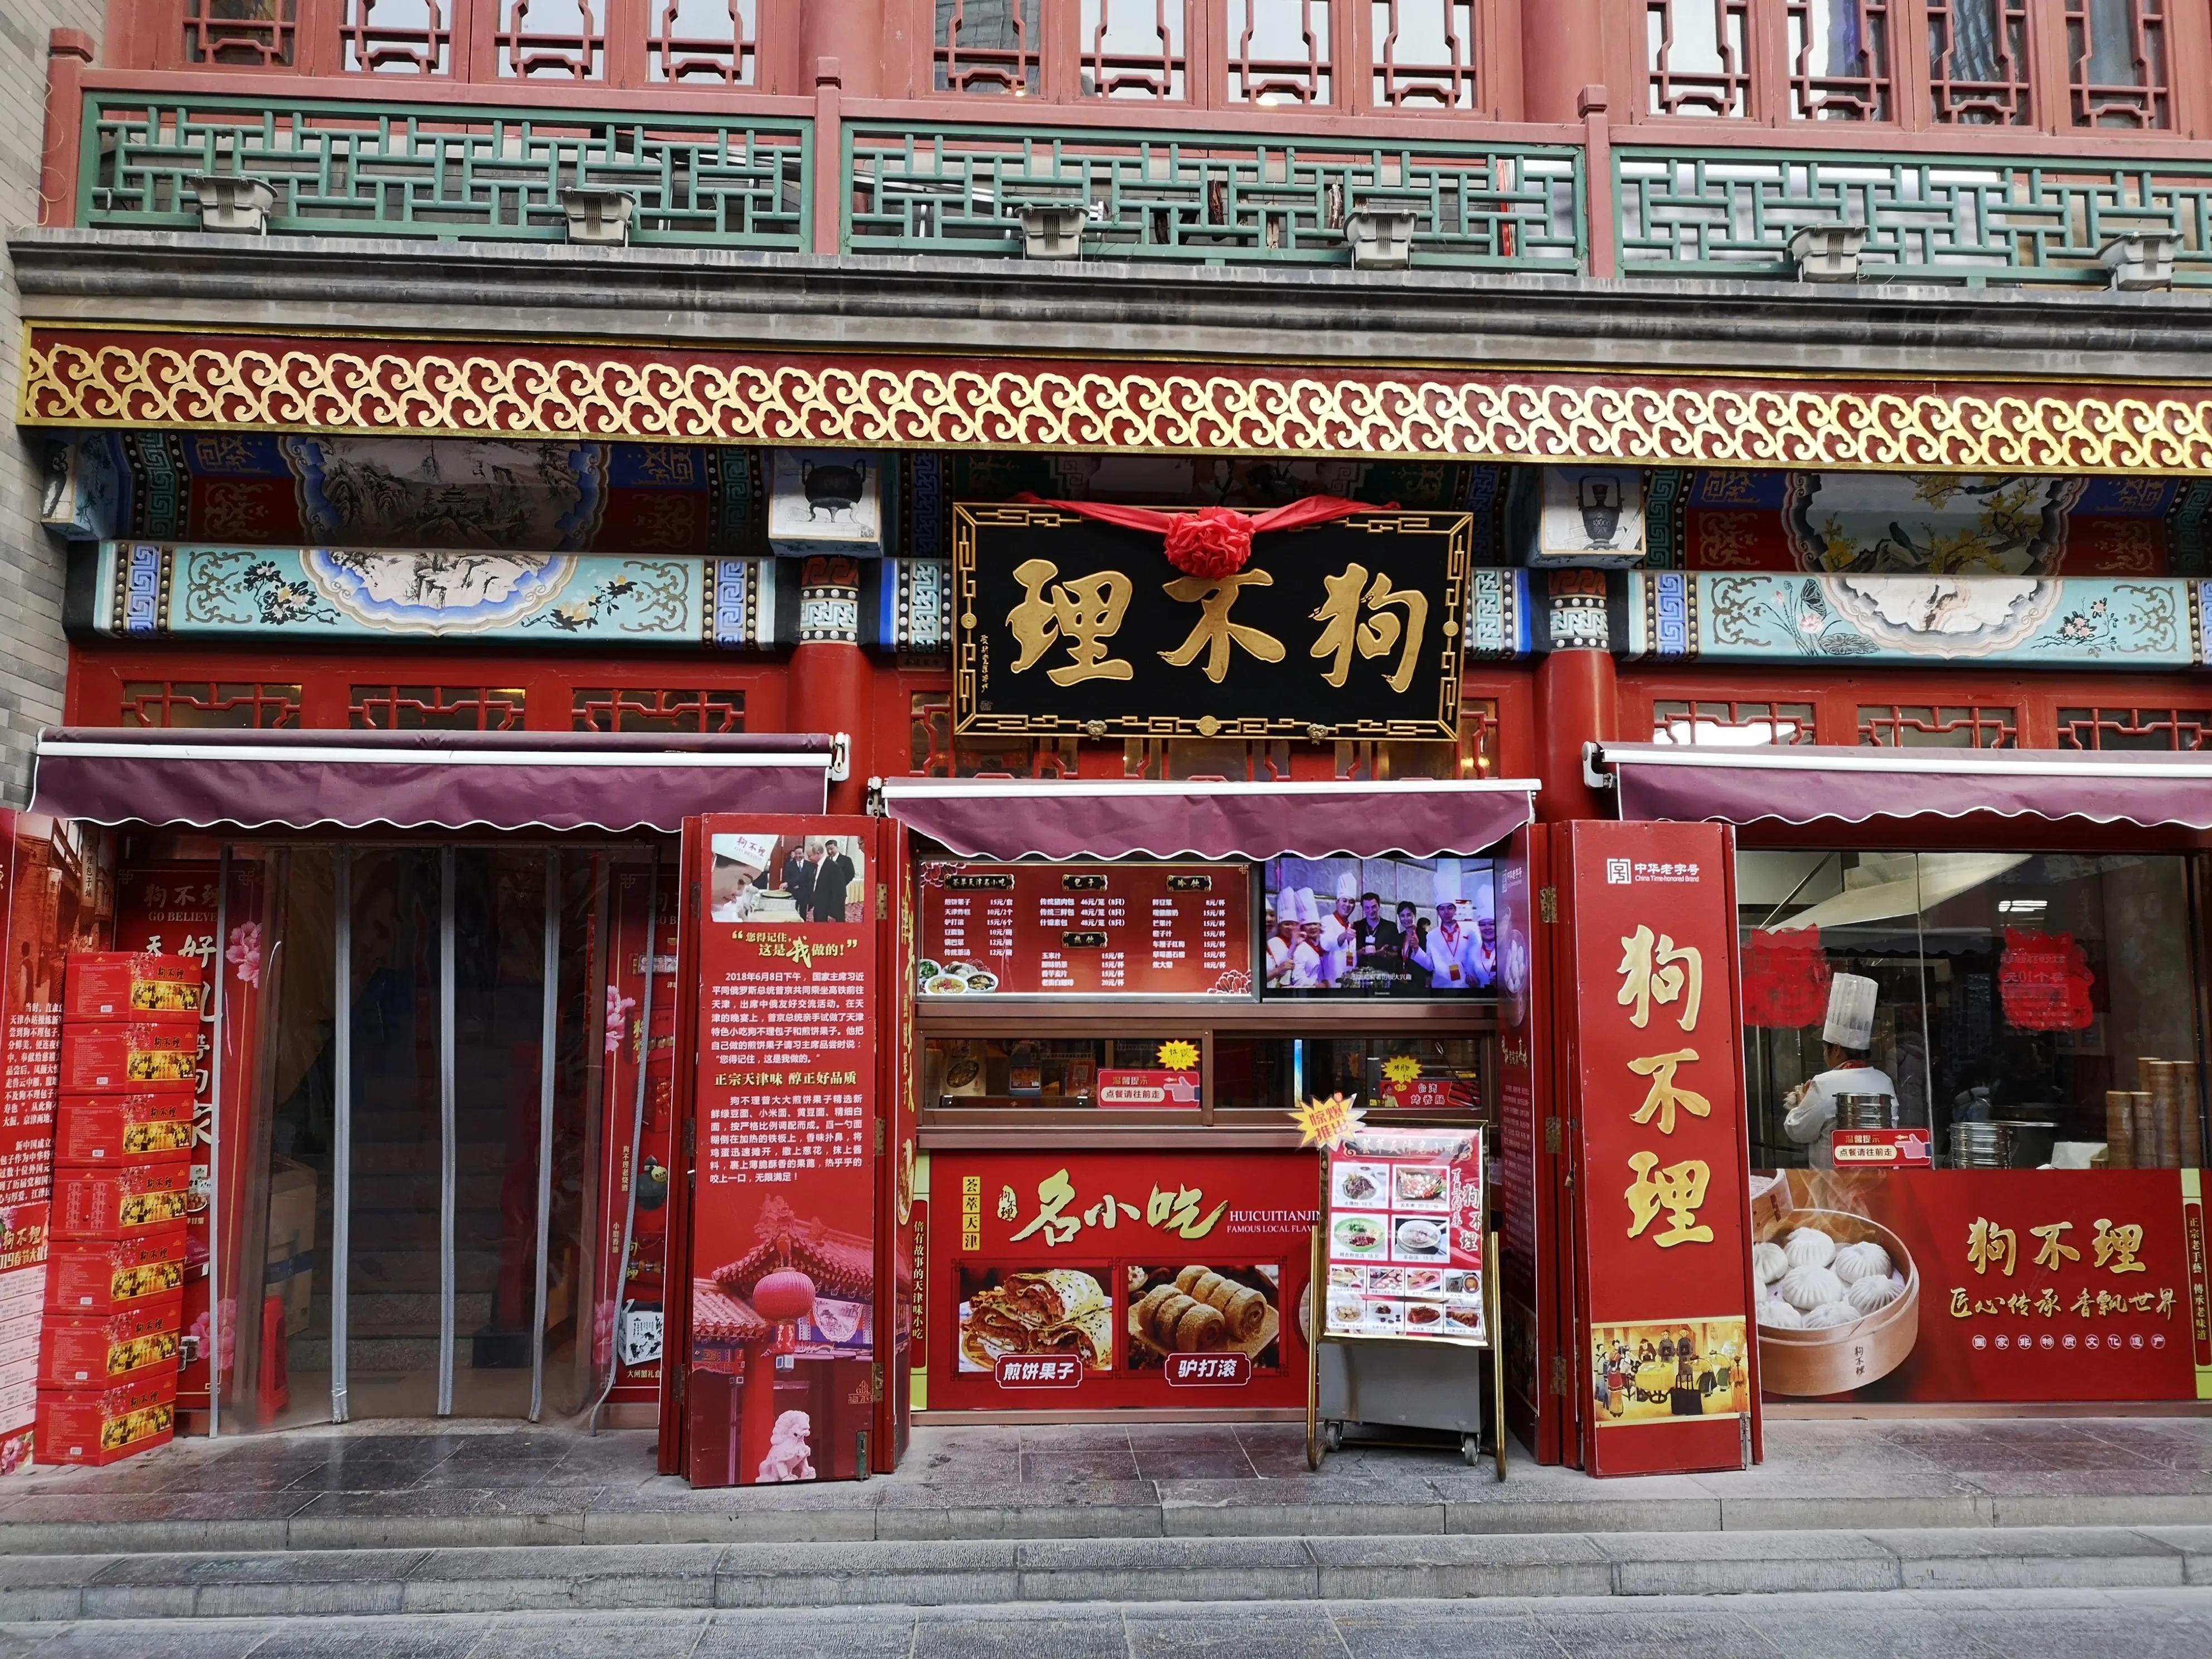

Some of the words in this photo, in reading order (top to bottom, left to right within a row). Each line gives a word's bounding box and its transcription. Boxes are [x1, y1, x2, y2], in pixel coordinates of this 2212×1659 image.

[1634, 863, 1700, 875] 中华老字号
[1074, 878, 1095, 887] 包子
[148, 912, 164, 921] GO
[711, 985, 865, 995] 平同俄罗斯总统普京共同乘坐高铁前往
[711, 998, 865, 1009] 天津，出席中俄友好交流活动。在天
[714, 1073, 783, 1086] 正宗天津味
[788, 1070, 857, 1085] 醇正好品质
[1113, 1076, 1148, 1085] 温馨提示
[1617, 924, 1714, 1248] 狗不理
[1106, 1090, 1160, 1099] 点餐请往前走
[1418, 1083, 1438, 1094] 台湾
[1410, 1094, 1445, 1105] 烤香肠
[1309, 1103, 1343, 1126] 惊爆
[1314, 1119, 1348, 1142] 推出
[1845, 1135, 1880, 1143] 温馨提示
[1840, 1148, 1893, 1157] 点餐请往前走
[964, 1177, 979, 1249] 荟萃天津
[1009, 1167, 1229, 1248] 名小吃
[3, 1225, 41, 1251] 狗不理
[1966, 1216, 2146, 1277] 狗不理
[912, 1221, 924, 1340] 倍有故事的天津味小吃
[1950, 1287, 2062, 1318] 匠心传承
[2070, 1287, 2177, 1321] 香飘世界
[1972, 1333, 2166, 1351] 国家非物质文化遗产
[1177, 1359, 1238, 1379] 驴打滚
[1854, 1346, 1865, 1376] 狗不理
[1003, 1361, 1074, 1382] 煎饼果子
